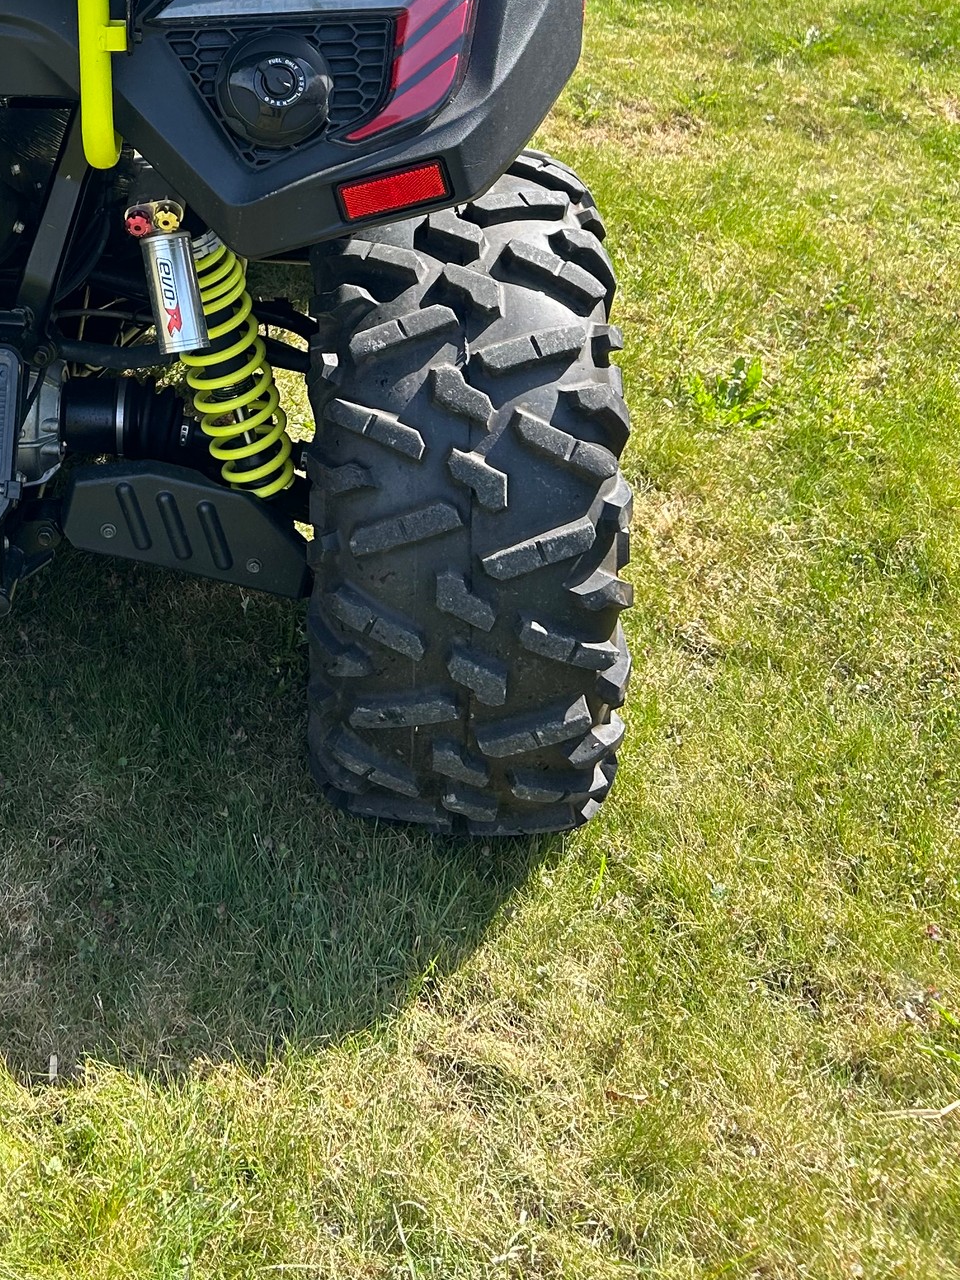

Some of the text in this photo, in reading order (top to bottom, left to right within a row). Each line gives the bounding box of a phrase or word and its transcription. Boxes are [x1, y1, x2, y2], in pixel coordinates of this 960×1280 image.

[268, 57, 299, 70] FUEL ONLY
[296, 76, 304, 96] LOCK
[264, 97, 288, 106] OPEN
